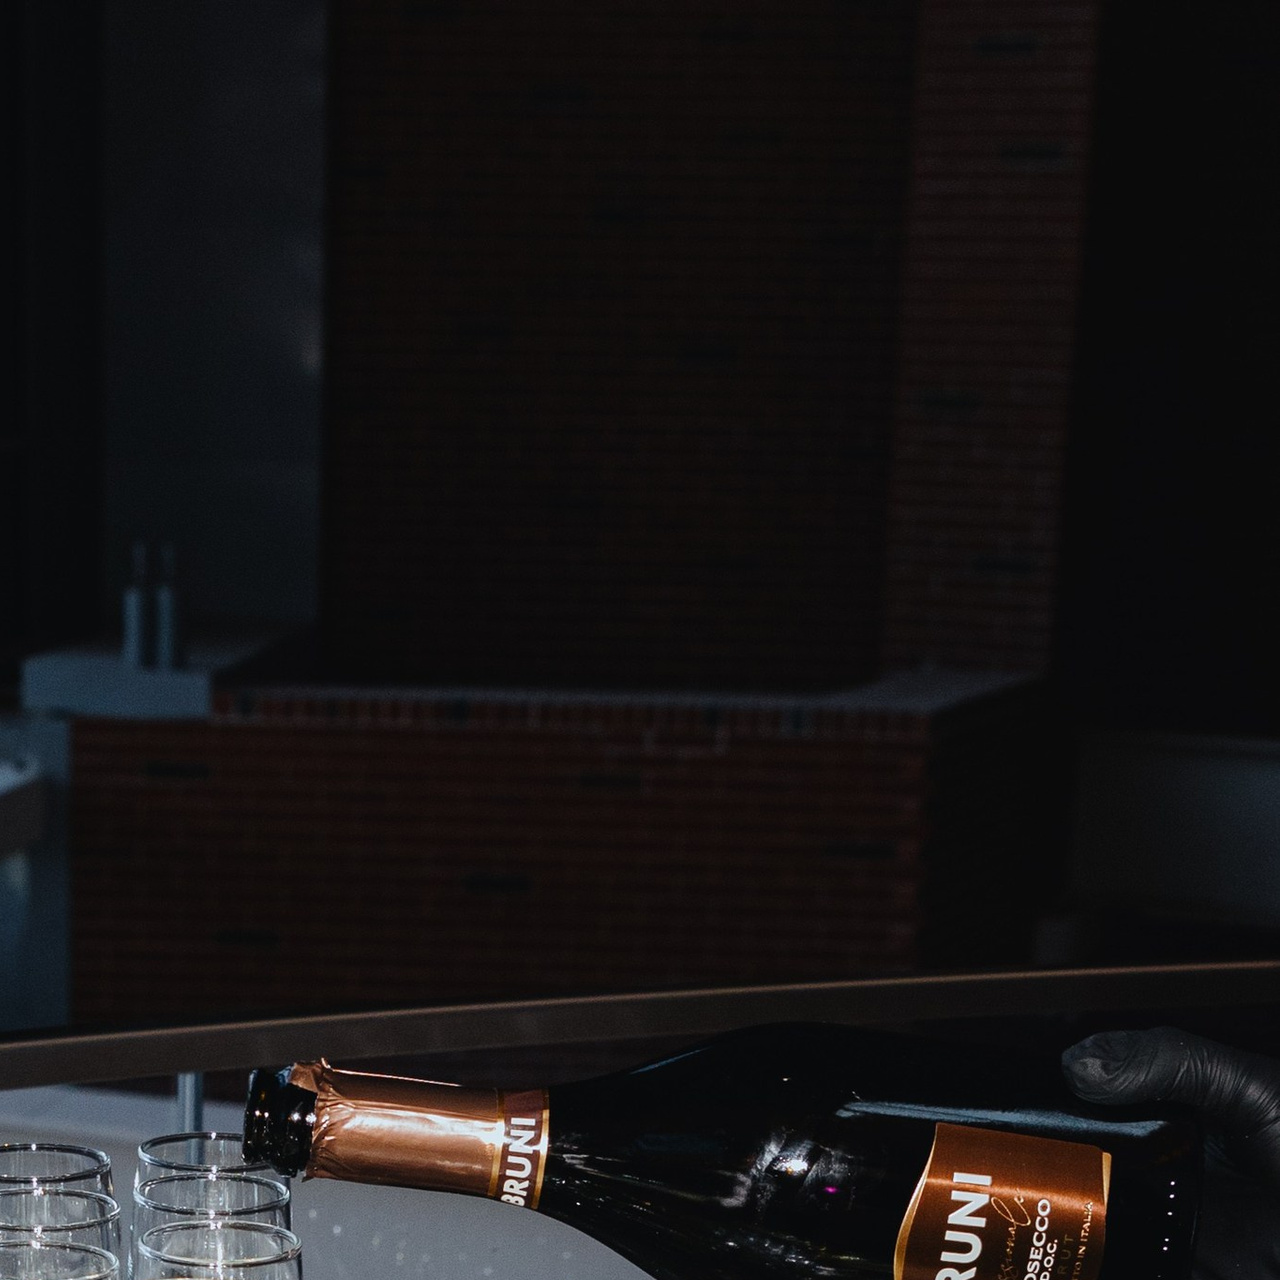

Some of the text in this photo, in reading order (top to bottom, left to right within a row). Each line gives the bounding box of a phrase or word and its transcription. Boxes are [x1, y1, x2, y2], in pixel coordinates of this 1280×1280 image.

[500, 1116, 536, 1207] BRUNI
[1079, 1201, 1093, 1242] ITALIA
[1077, 1245, 1086, 1259] IN
